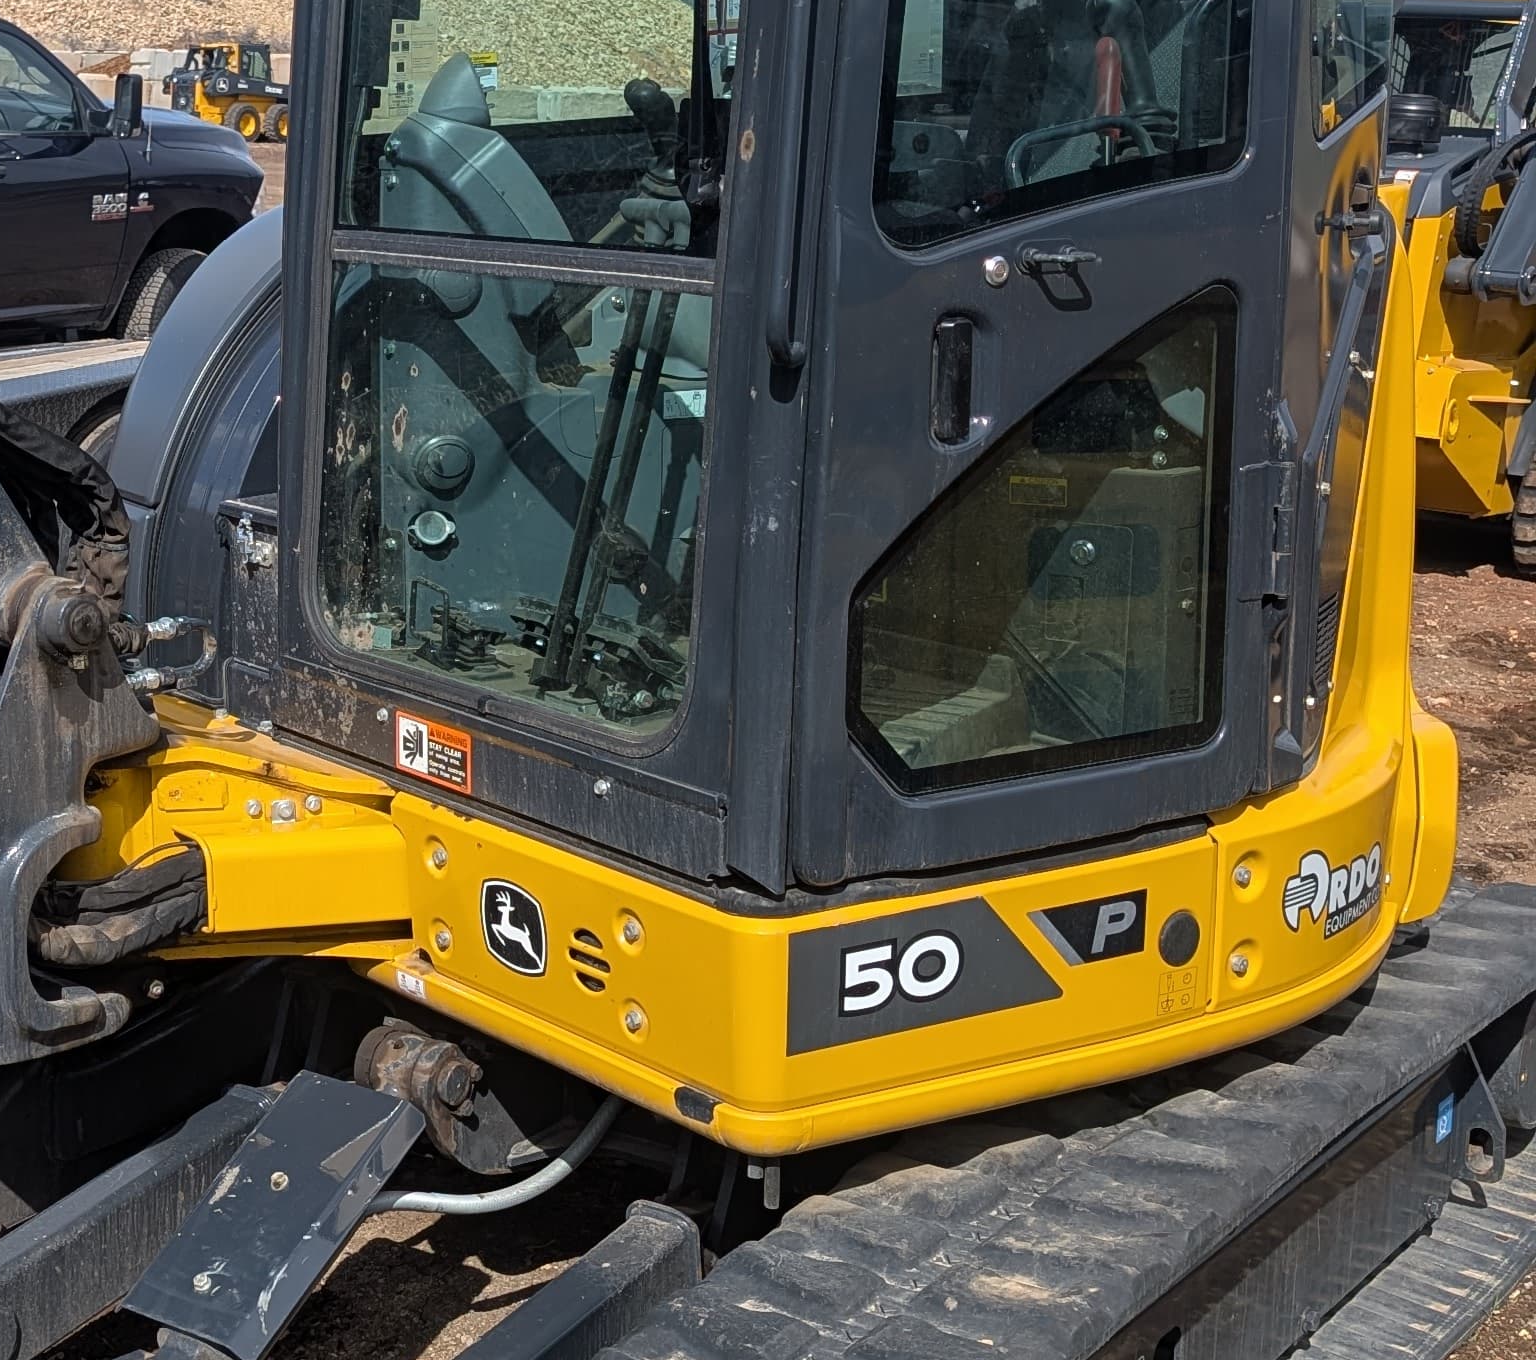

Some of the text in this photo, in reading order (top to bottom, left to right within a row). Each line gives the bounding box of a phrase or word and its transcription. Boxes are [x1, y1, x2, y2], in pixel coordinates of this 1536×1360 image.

[92, 193, 128, 205] RAM
[1091, 900, 1137, 955] P
[1325, 892, 1372, 936] EQUIPMENT
[843, 934, 961, 1013] 50
